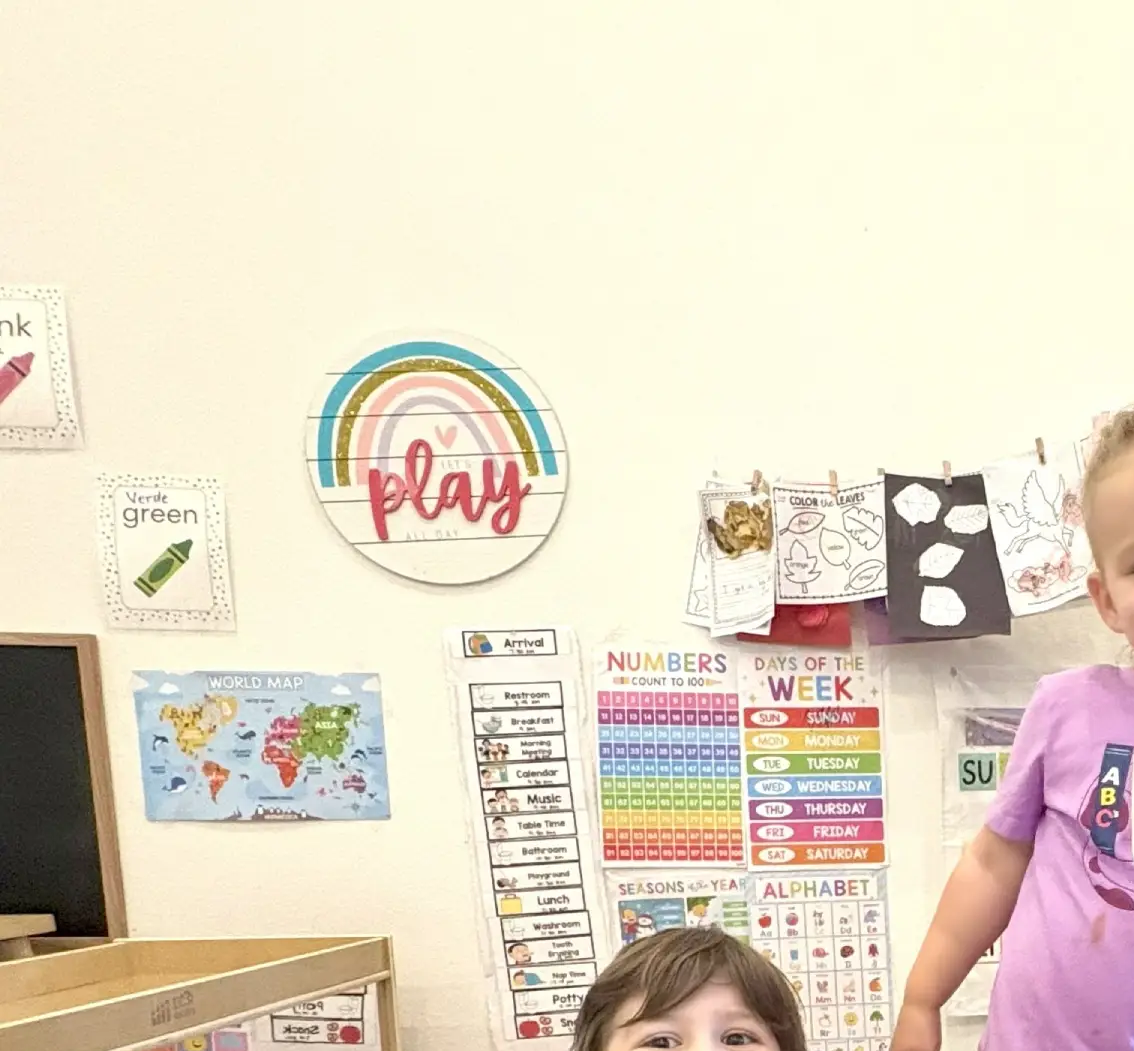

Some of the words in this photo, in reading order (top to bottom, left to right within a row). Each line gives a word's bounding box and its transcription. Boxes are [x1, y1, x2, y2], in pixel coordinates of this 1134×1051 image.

[0, 313, 32, 337] nk
[368, 439, 531, 541] play
[126, 491, 169, 504] Verde
[789, 496, 819, 506] COLOR
[820, 498, 834, 508] the
[836, 492, 866, 506] LEAVES
[122, 506, 198, 529] green
[504, 637, 544, 649] Arrival
[607, 651, 727, 673] NUMBERS
[755, 657, 798, 671] DAYS
[804, 657, 827, 671] OF
[834, 657, 865, 671] THE
[208, 676, 263, 690] WORLD
[267, 676, 304, 690] MAP
[631, 677, 666, 686] COUNT
[671, 677, 684, 686] TO
[687, 677, 705, 687] 100
[768, 675, 853, 702] WEEK
[504, 691, 551, 700] Restroom
[511, 717, 554, 726] Breakfast
[759, 713, 781, 723] SUN
[806, 711, 856, 725] SUNDAY
[758, 735, 784, 745] MON
[804, 735, 861, 747] MONDAY
[762, 760, 782, 769] TUE
[807, 757, 861, 770] TUESDAY
[516, 769, 559, 779] Calendar
[762, 782, 785, 792] WED
[796, 780, 872, 793] WEDNESDAY
[527, 793, 563, 805] Music
[765, 805, 785, 815] THU
[804, 803, 868, 816] THURSDAY
[517, 821, 543, 831] Table
[545, 820, 566, 828] Time
[766, 828, 785, 837] FRI
[813, 825, 860, 838] FRIDAY
[522, 846, 568, 856] Bathroom
[768, 851, 786, 860] SAT
[806, 848, 870, 861] SATURDAY
[618, 881, 685, 895] SEASONS
[710, 878, 746, 892] YEAR
[763, 879, 870, 899] ALPHABET
[536, 895, 570, 906] Lunch
[532, 920, 581, 931] Washroom
[552, 993, 584, 1006] Potty
